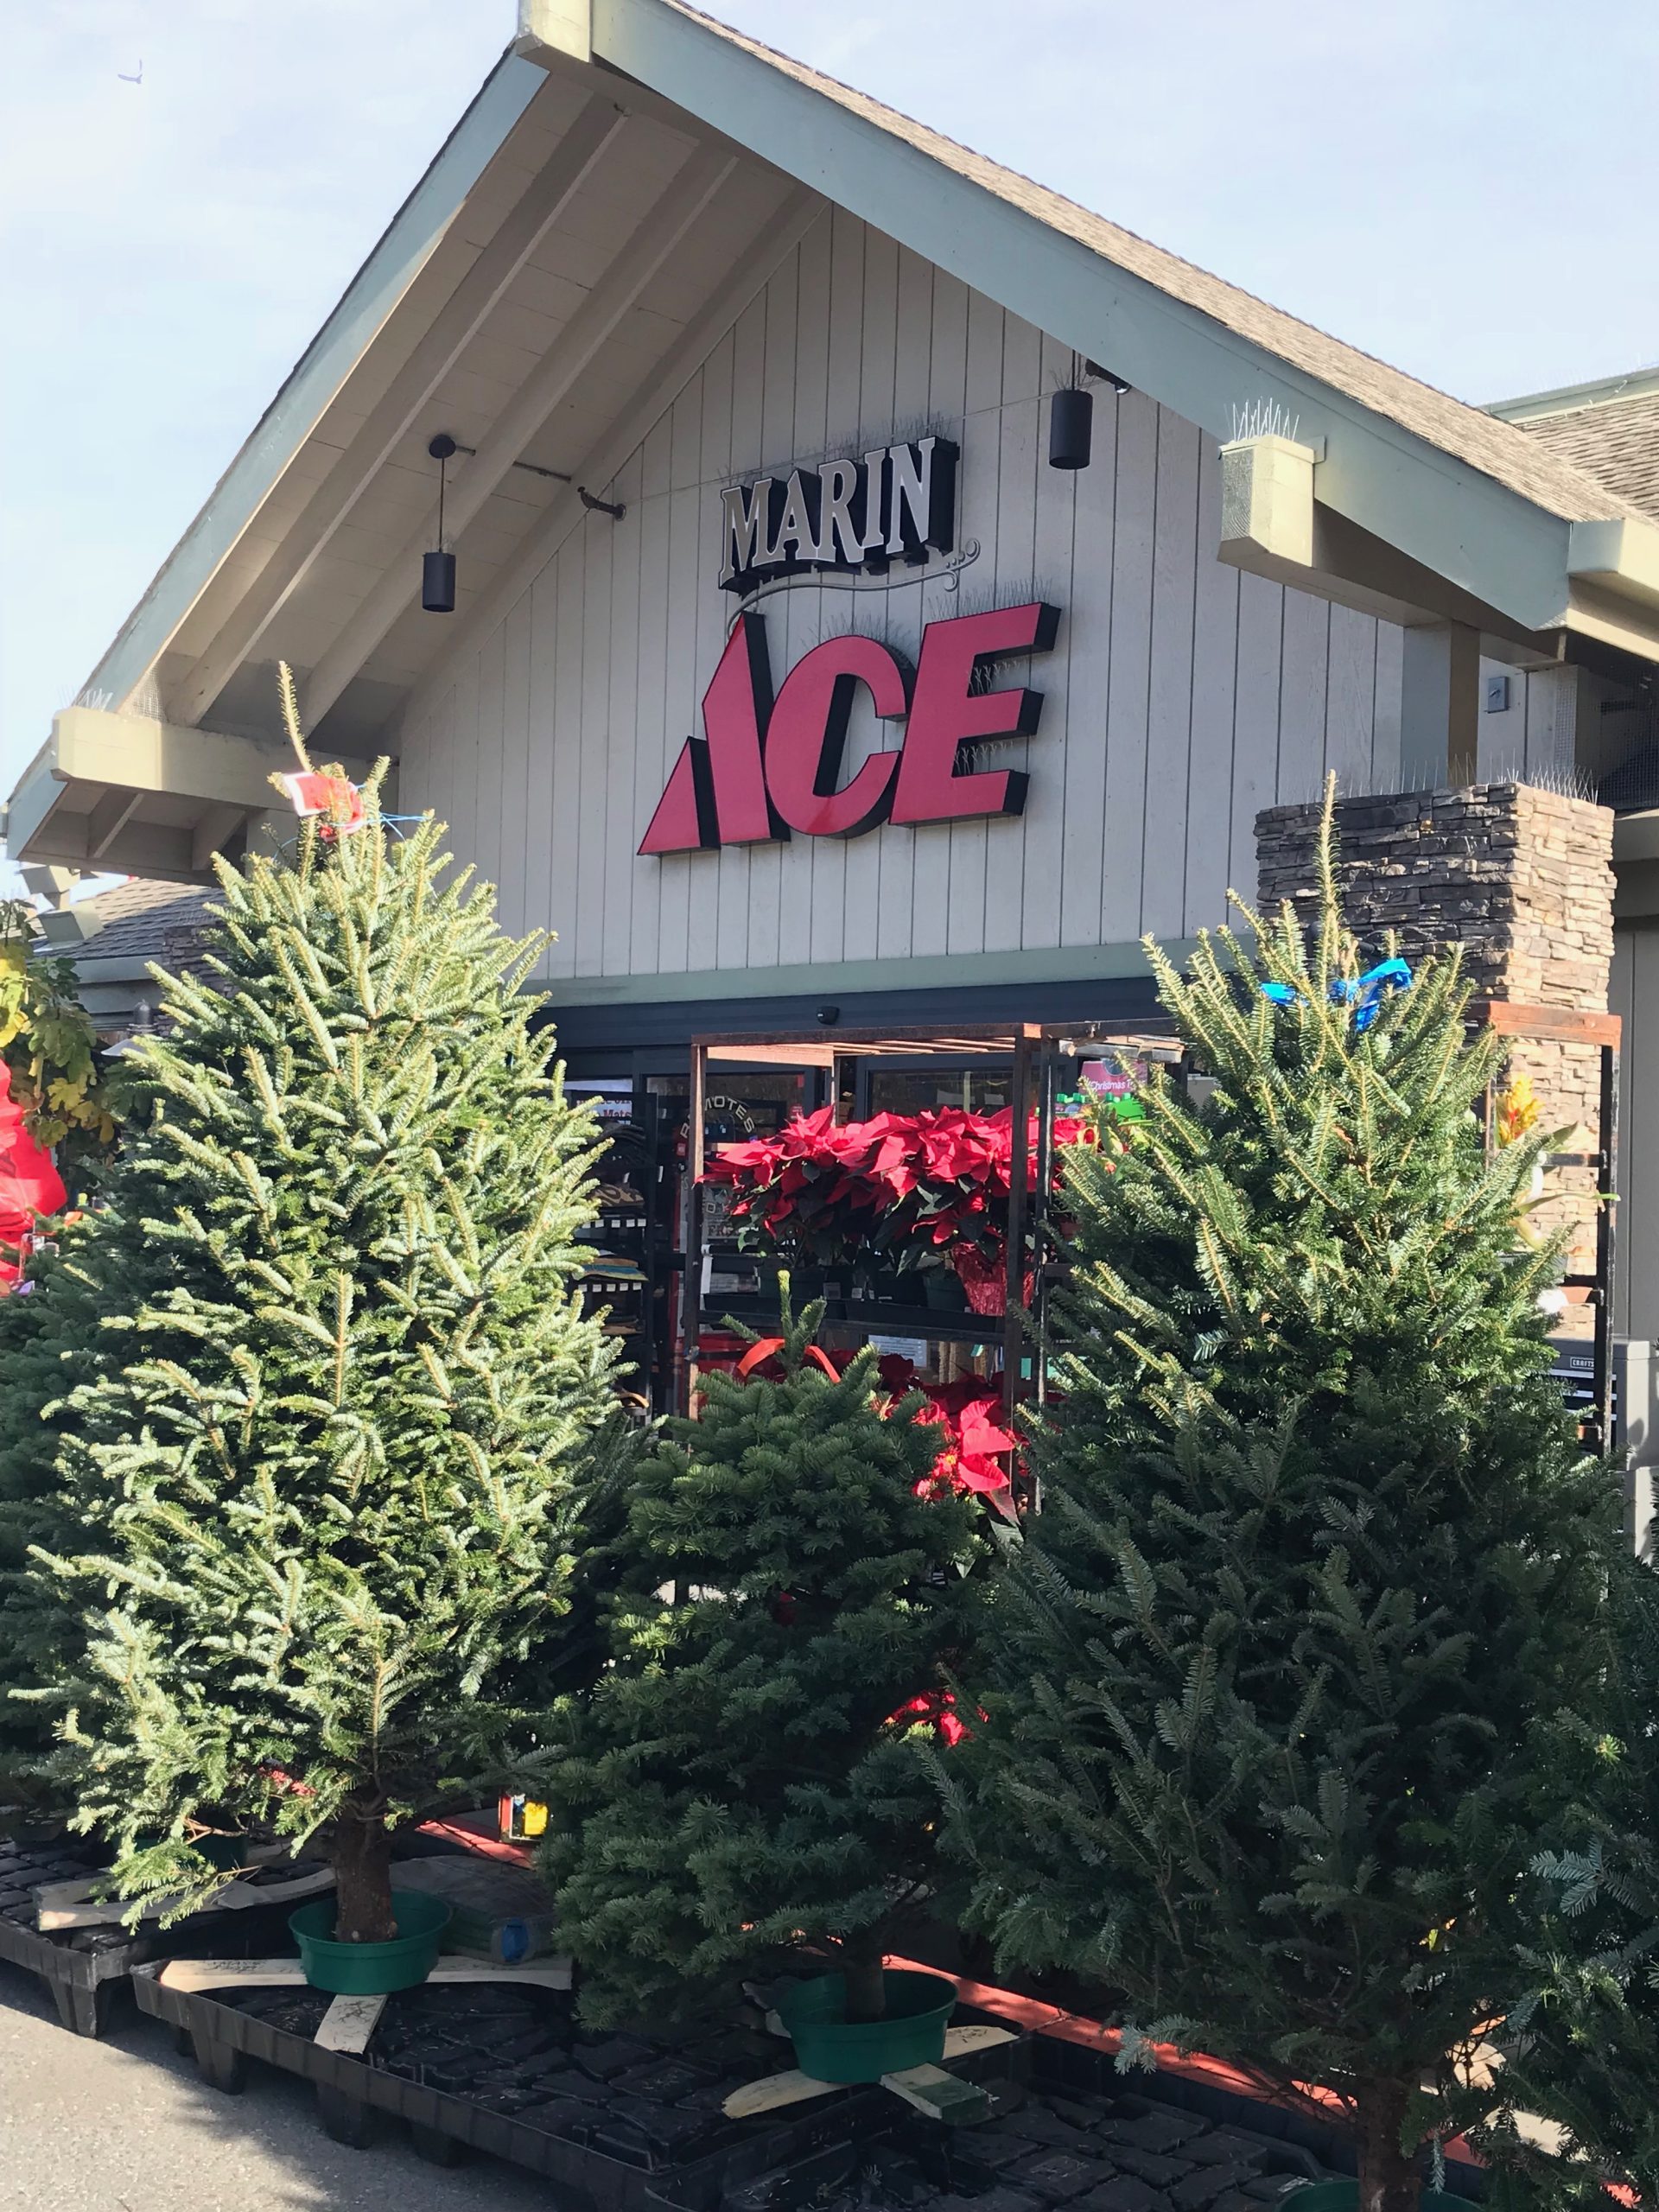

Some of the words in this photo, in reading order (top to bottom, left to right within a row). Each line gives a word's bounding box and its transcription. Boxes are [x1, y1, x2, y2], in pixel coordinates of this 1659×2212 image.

[718, 435, 942, 591] MARIN
[637, 601, 1047, 855] ACE
[1090, 1080, 1127, 1091] Christmas
[680, 1096, 755, 1139] RMOTES
[1573, 1359, 1595, 1368] CRAFTS
